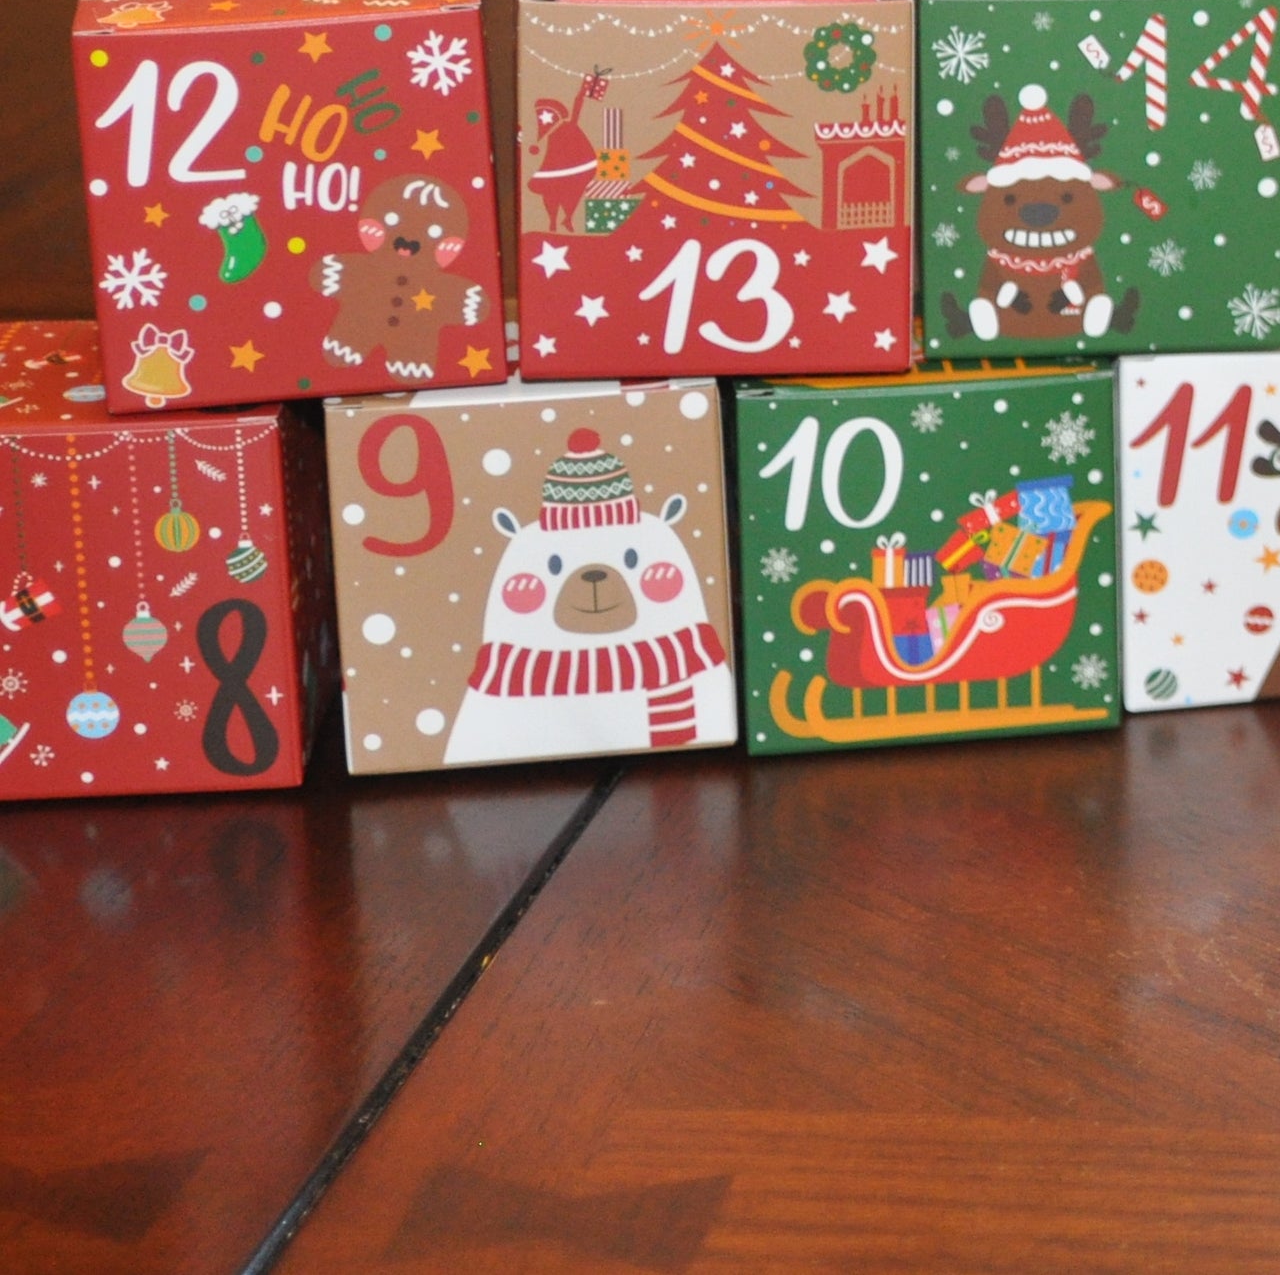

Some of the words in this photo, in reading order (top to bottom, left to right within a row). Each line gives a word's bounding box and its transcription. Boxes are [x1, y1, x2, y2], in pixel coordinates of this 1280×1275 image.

[95, 60, 247, 187] 12
[259, 83, 348, 162] HO
[336, 68, 402, 135] HO
[1115, 6, 1279, 131] 14
[282, 161, 360, 212] HO!
[639, 238, 795, 355] 13
[357, 413, 454, 557] 9
[759, 416, 904, 531] 10
[1129, 382, 1253, 507] 11
[196, 597, 279, 776] 8
